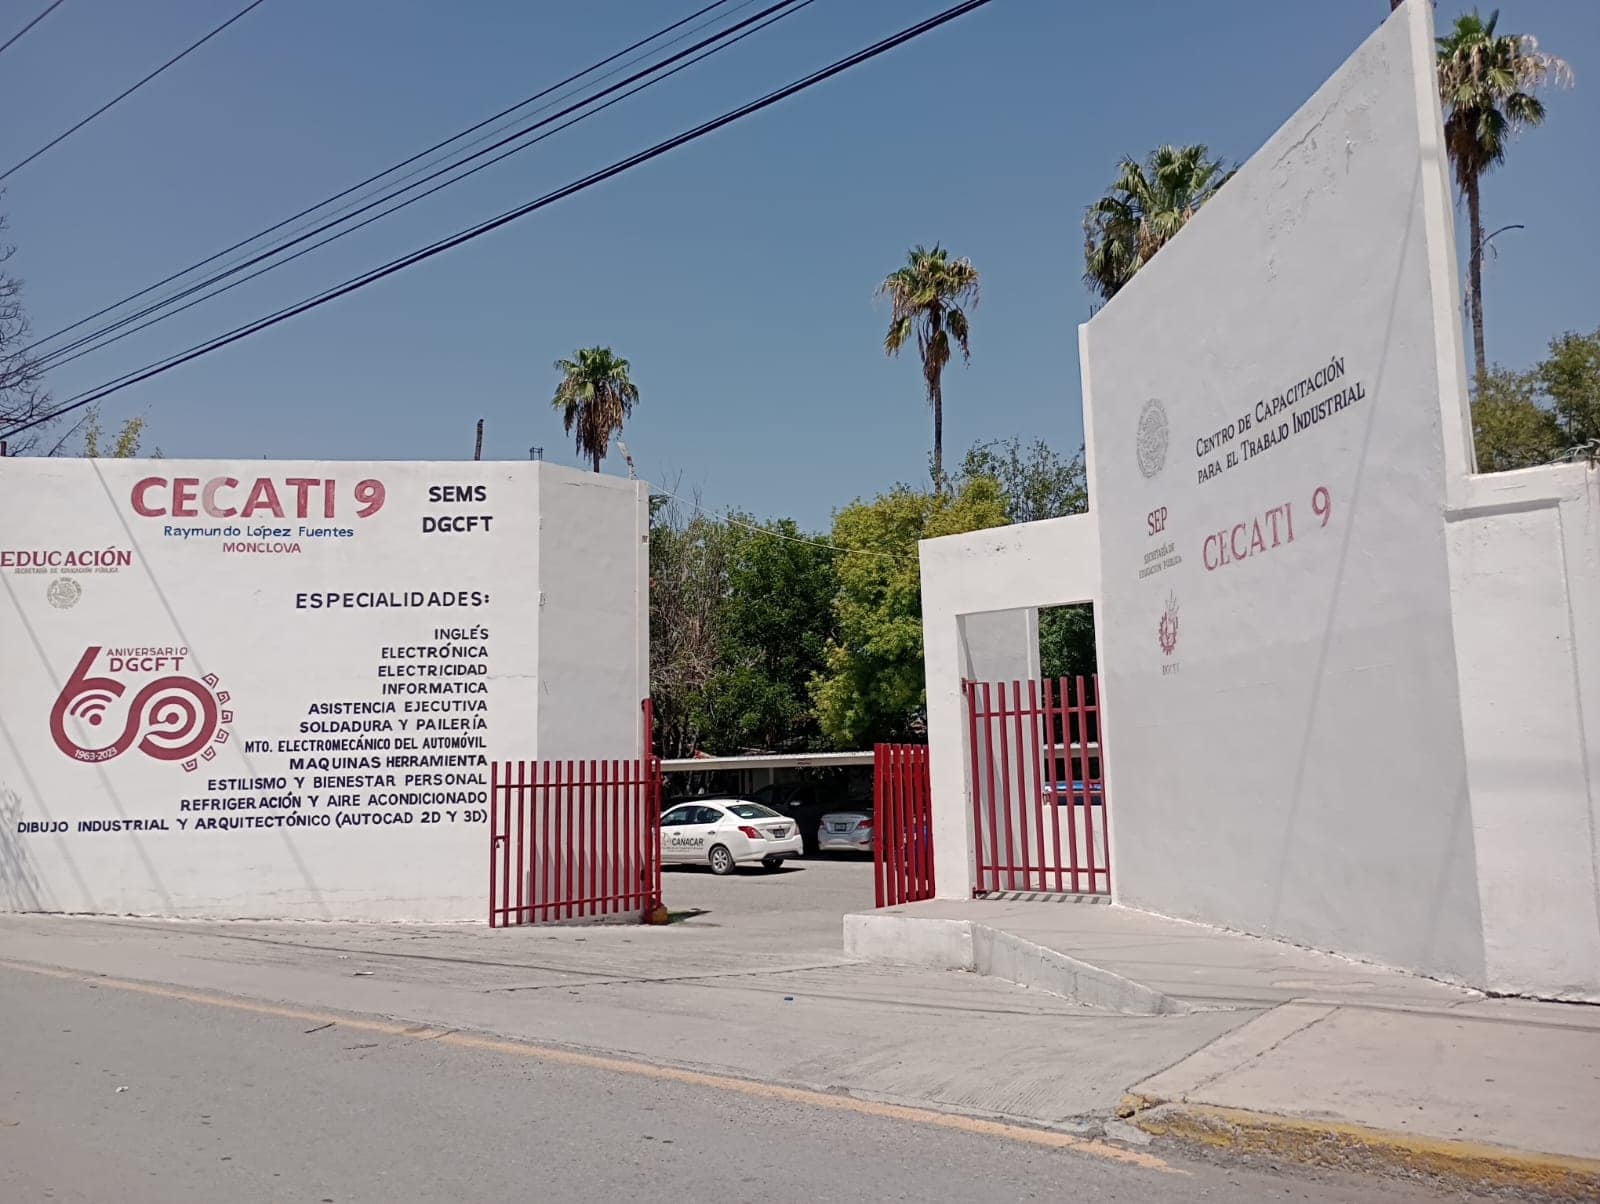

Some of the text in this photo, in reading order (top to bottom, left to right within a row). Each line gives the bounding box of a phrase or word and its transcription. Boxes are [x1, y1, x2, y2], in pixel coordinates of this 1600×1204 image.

[1196, 424, 1235, 458] CENTRO
[1238, 413, 1251, 434] DE
[1255, 355, 1346, 424] CAPACITACIÓN
[1197, 381, 1366, 485] PARA EL TRABAJO INDUSTRIAL
[130, 475, 386, 519] CECATI 9
[428, 485, 487, 503] SEMS
[421, 515, 493, 534] DGCFT
[1147, 506, 1168, 537] SEP
[1202, 486, 1331, 572] CECATI 9
[163, 524, 354, 539] Raymundo López Fuentes
[0, 546, 132, 568] EDUCACIÓN
[222, 542, 302, 554] MONCLOVA
[295, 591, 490, 609] ESPECIALIDADES:
[434, 624, 489, 640] INGLÉS
[106, 646, 188, 657] ANIVERSARIO
[381, 642, 489, 659] ELECTRÓNICA
[109, 656, 185, 673] DGCFT
[378, 663, 488, 678] ELECTRICIDAD
[382, 681, 489, 695] INFORMATICA
[308, 699, 488, 715] ASISTENCIA EJECUTIVA
[299, 713, 488, 733] SOLDADURA Y PAILERÍA
[244, 731, 487, 753] MTO. ELECTROMECÁNICO DEL AUTOMÓVIL
[289, 754, 488, 772] MAQUINAS HERRAMIENTA
[207, 773, 487, 791] ESTILISMO Y BIENESTAR PERSONAL
[180, 791, 488, 812] REFRIGERACIÓN Y AIRE ACONDICIONADO
[17, 809, 488, 834] DIBUJO INDUSTRIAL Y ARQUITECTÓNICO (AUTOCAD 2D Y 3D)
